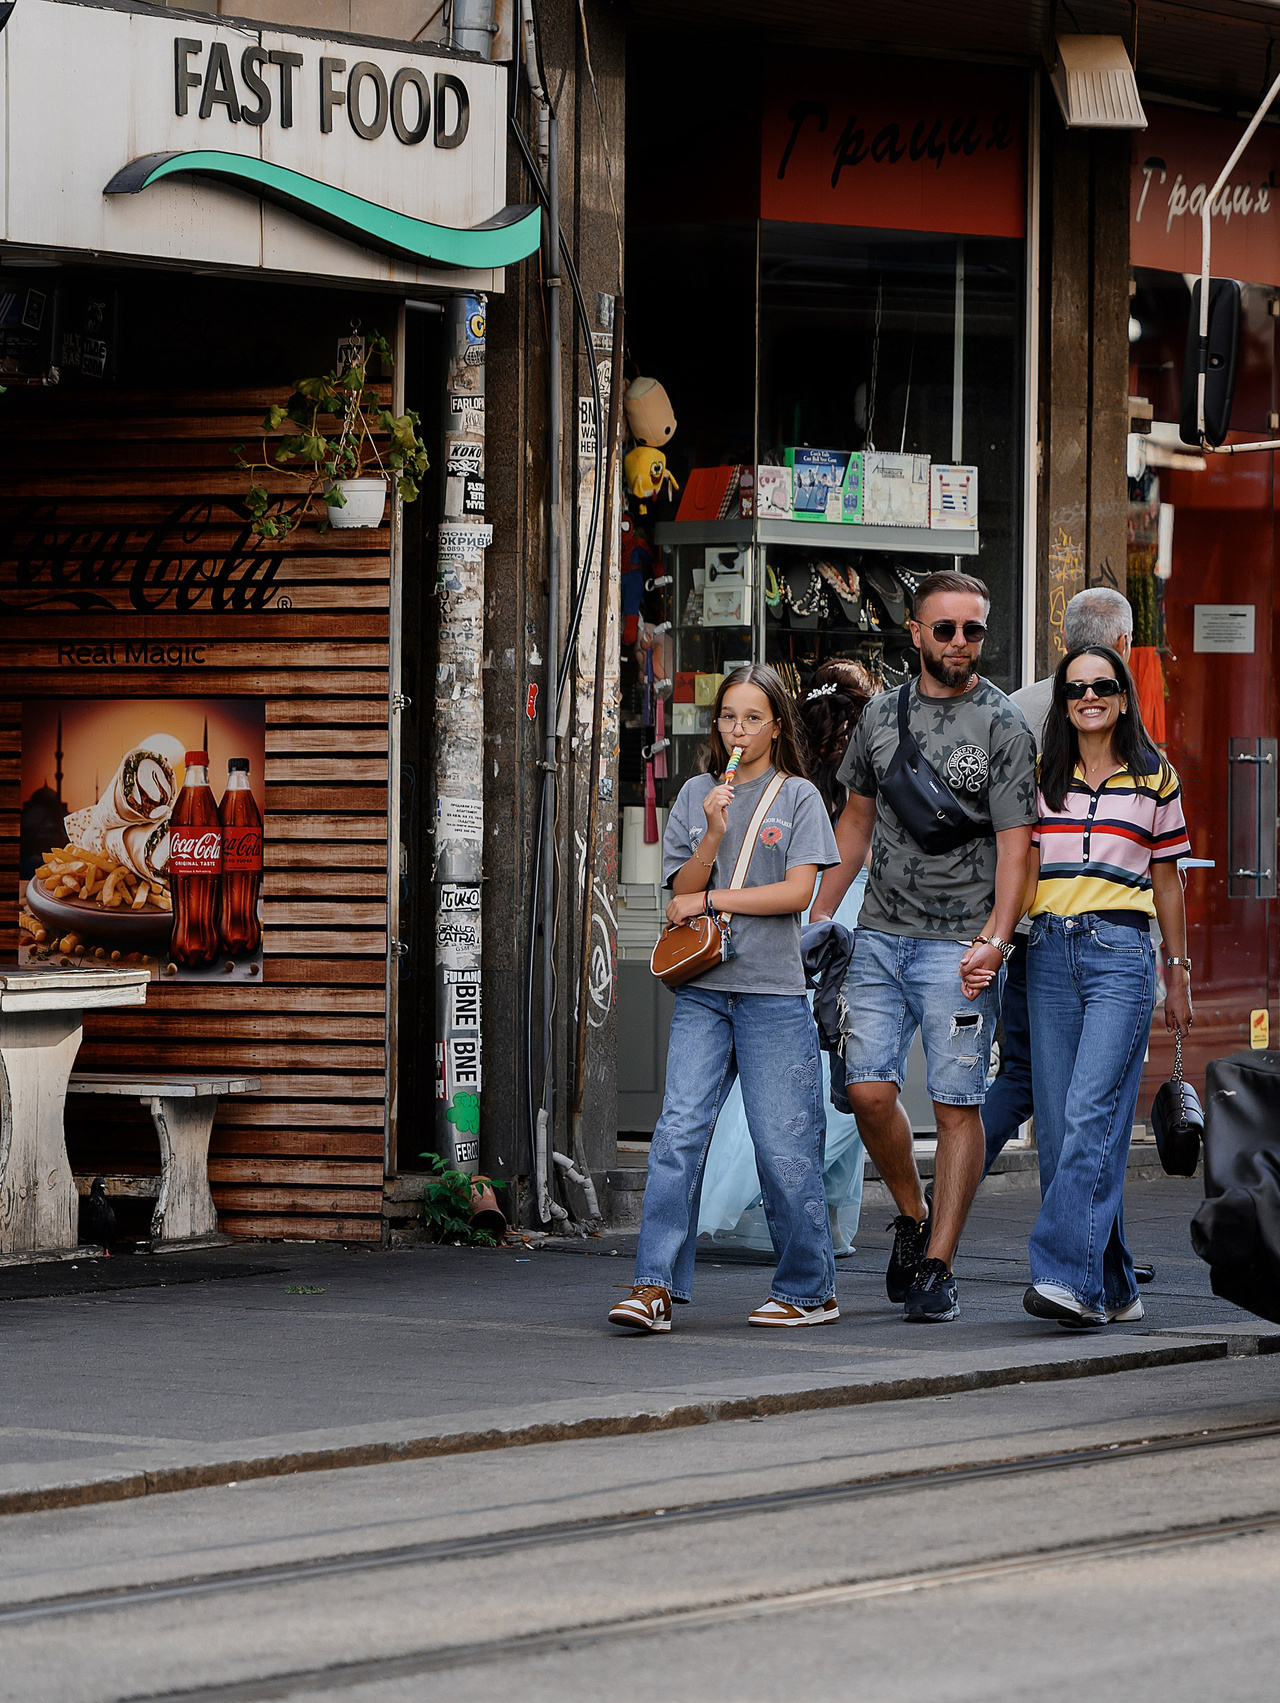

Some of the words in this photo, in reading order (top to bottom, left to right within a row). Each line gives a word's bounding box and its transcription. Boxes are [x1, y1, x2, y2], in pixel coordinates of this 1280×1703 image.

[174, 37, 303, 128] FAST
[319, 56, 470, 149] FOOD
[777, 100, 1014, 189] Грация
[581, 401, 596, 424] BN
[581, 427, 596, 439] WA
[451, 446, 482, 458] KOKO
[581, 441, 596, 453] HER
[438, 537, 491, 546] ОКРИВИ
[58, 642, 116, 664] Real
[125, 642, 206, 667] Magic
[950, 746, 973, 768] BROKEN
[170, 832, 221, 859] Coca-Cola
[456, 985, 477, 1026] BNE
[454, 1042, 477, 1083] BNE
